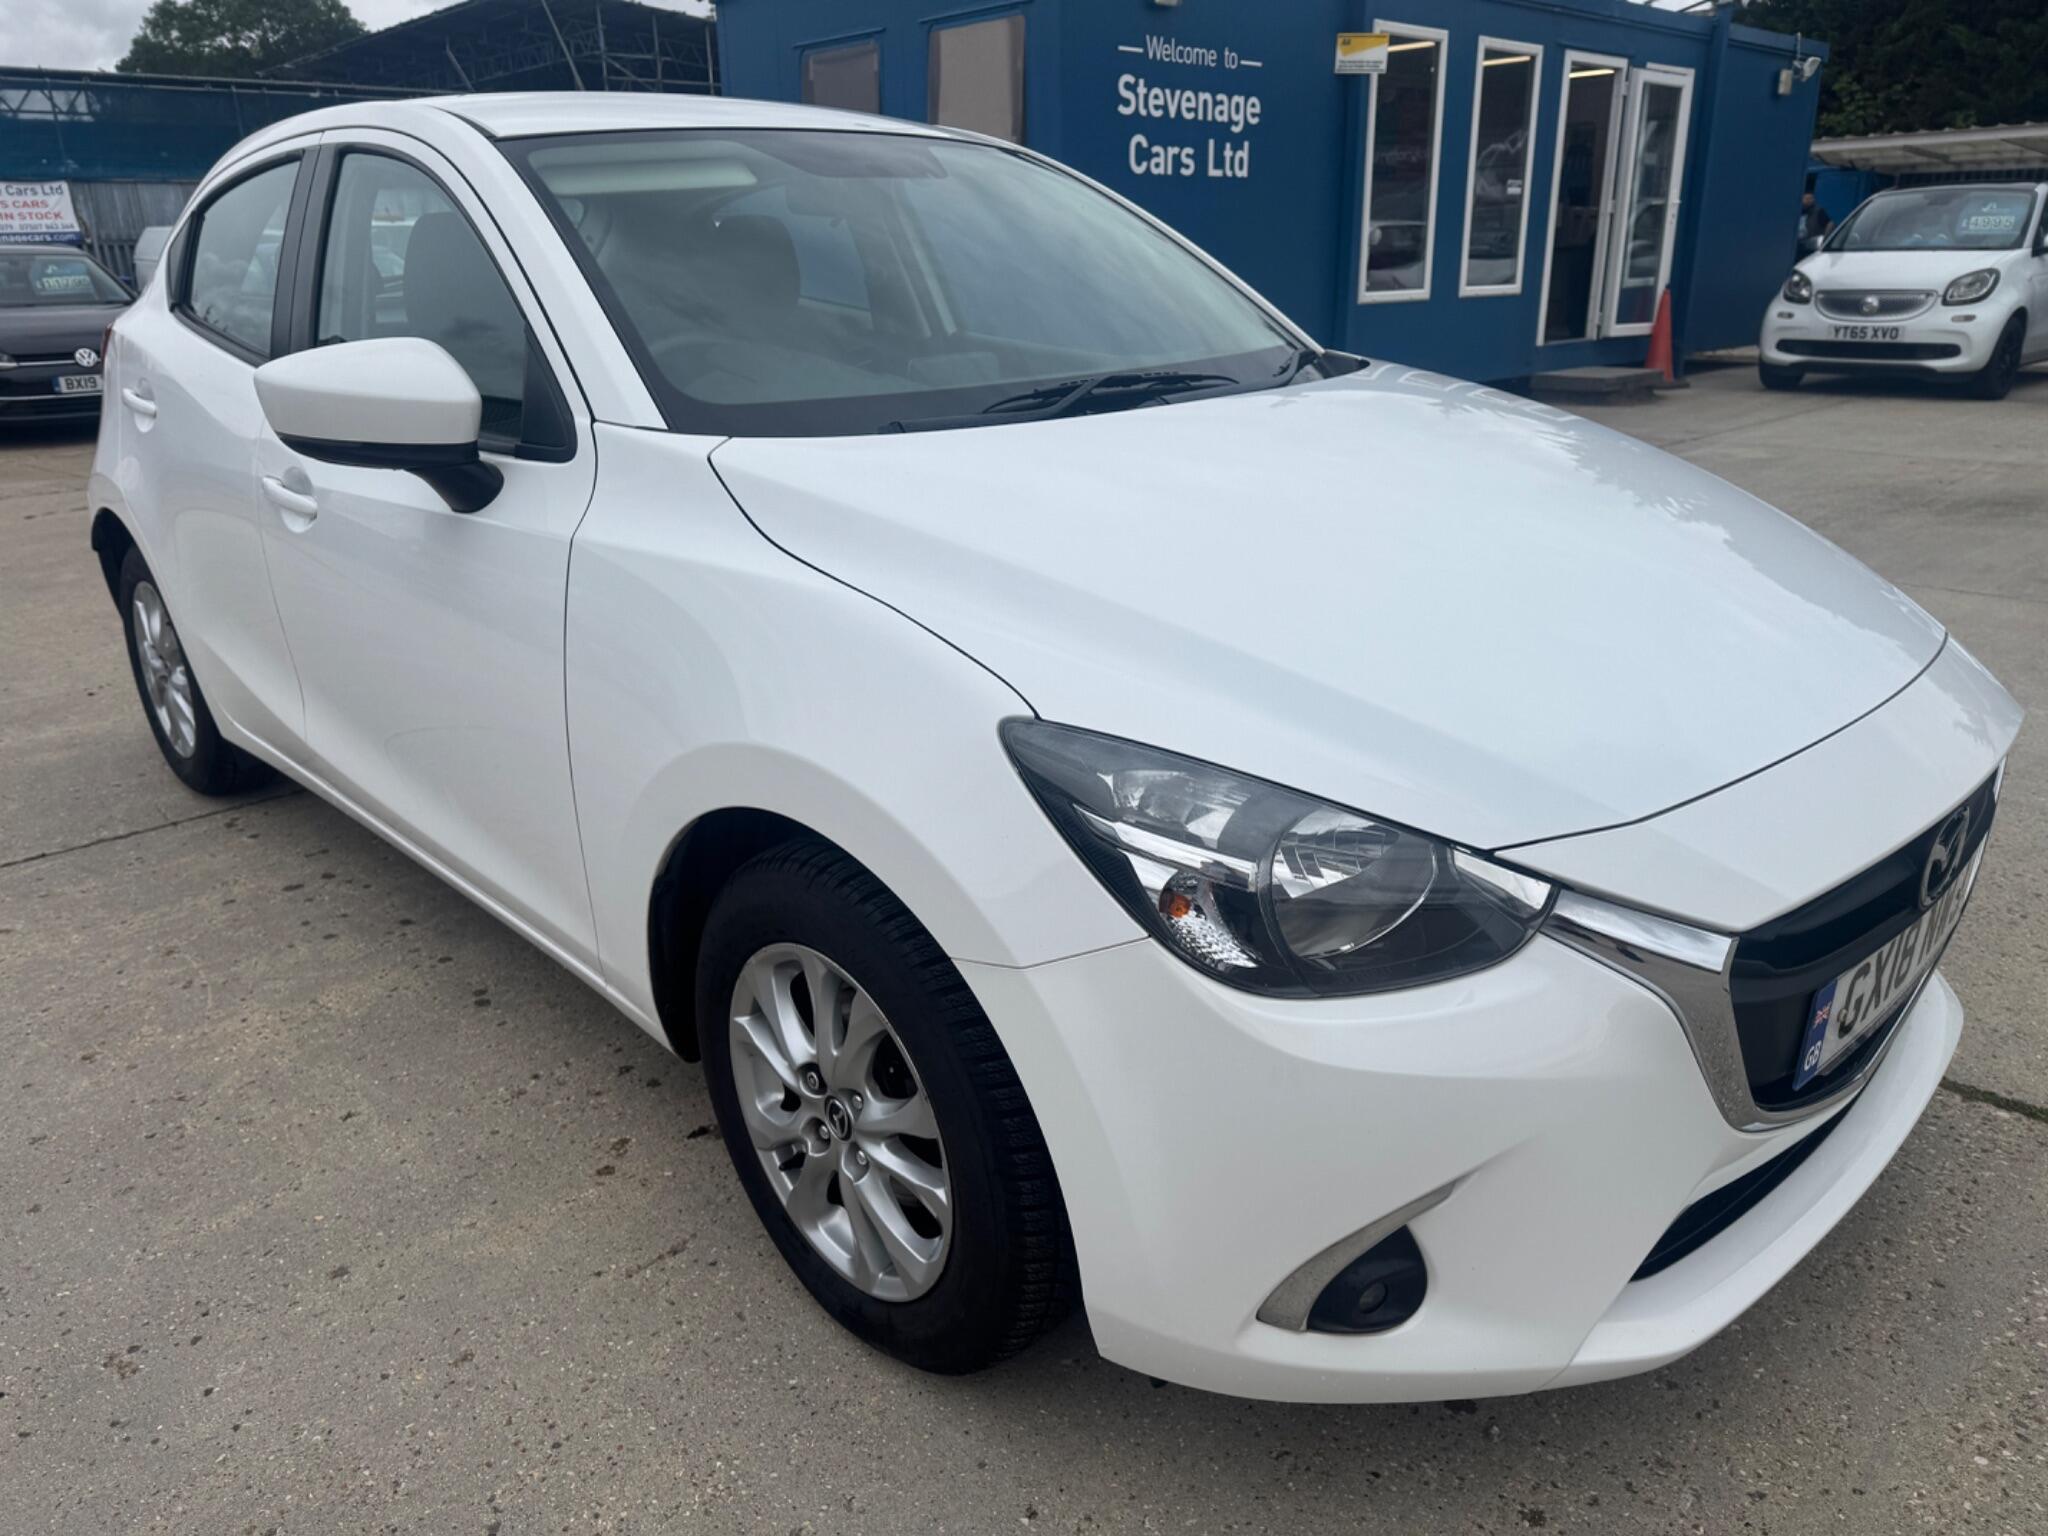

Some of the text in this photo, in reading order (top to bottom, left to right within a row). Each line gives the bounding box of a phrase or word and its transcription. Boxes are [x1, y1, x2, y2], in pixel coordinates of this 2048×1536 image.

[1146, 34, 1238, 69] Welcome to
[1117, 73, 1261, 133] Stevenage
[1129, 134, 1249, 178] Cars Ltd
[5, 184, 64, 196] Cars Ltd
[12, 200, 48, 208] CARS
[18, 211, 64, 220] STOCK
[1833, 326, 1900, 340] YT65 XVO
[65, 376, 97, 391] BX19
[1837, 922, 1921, 1039] GX18
[1804, 1040, 1821, 1071] GB
